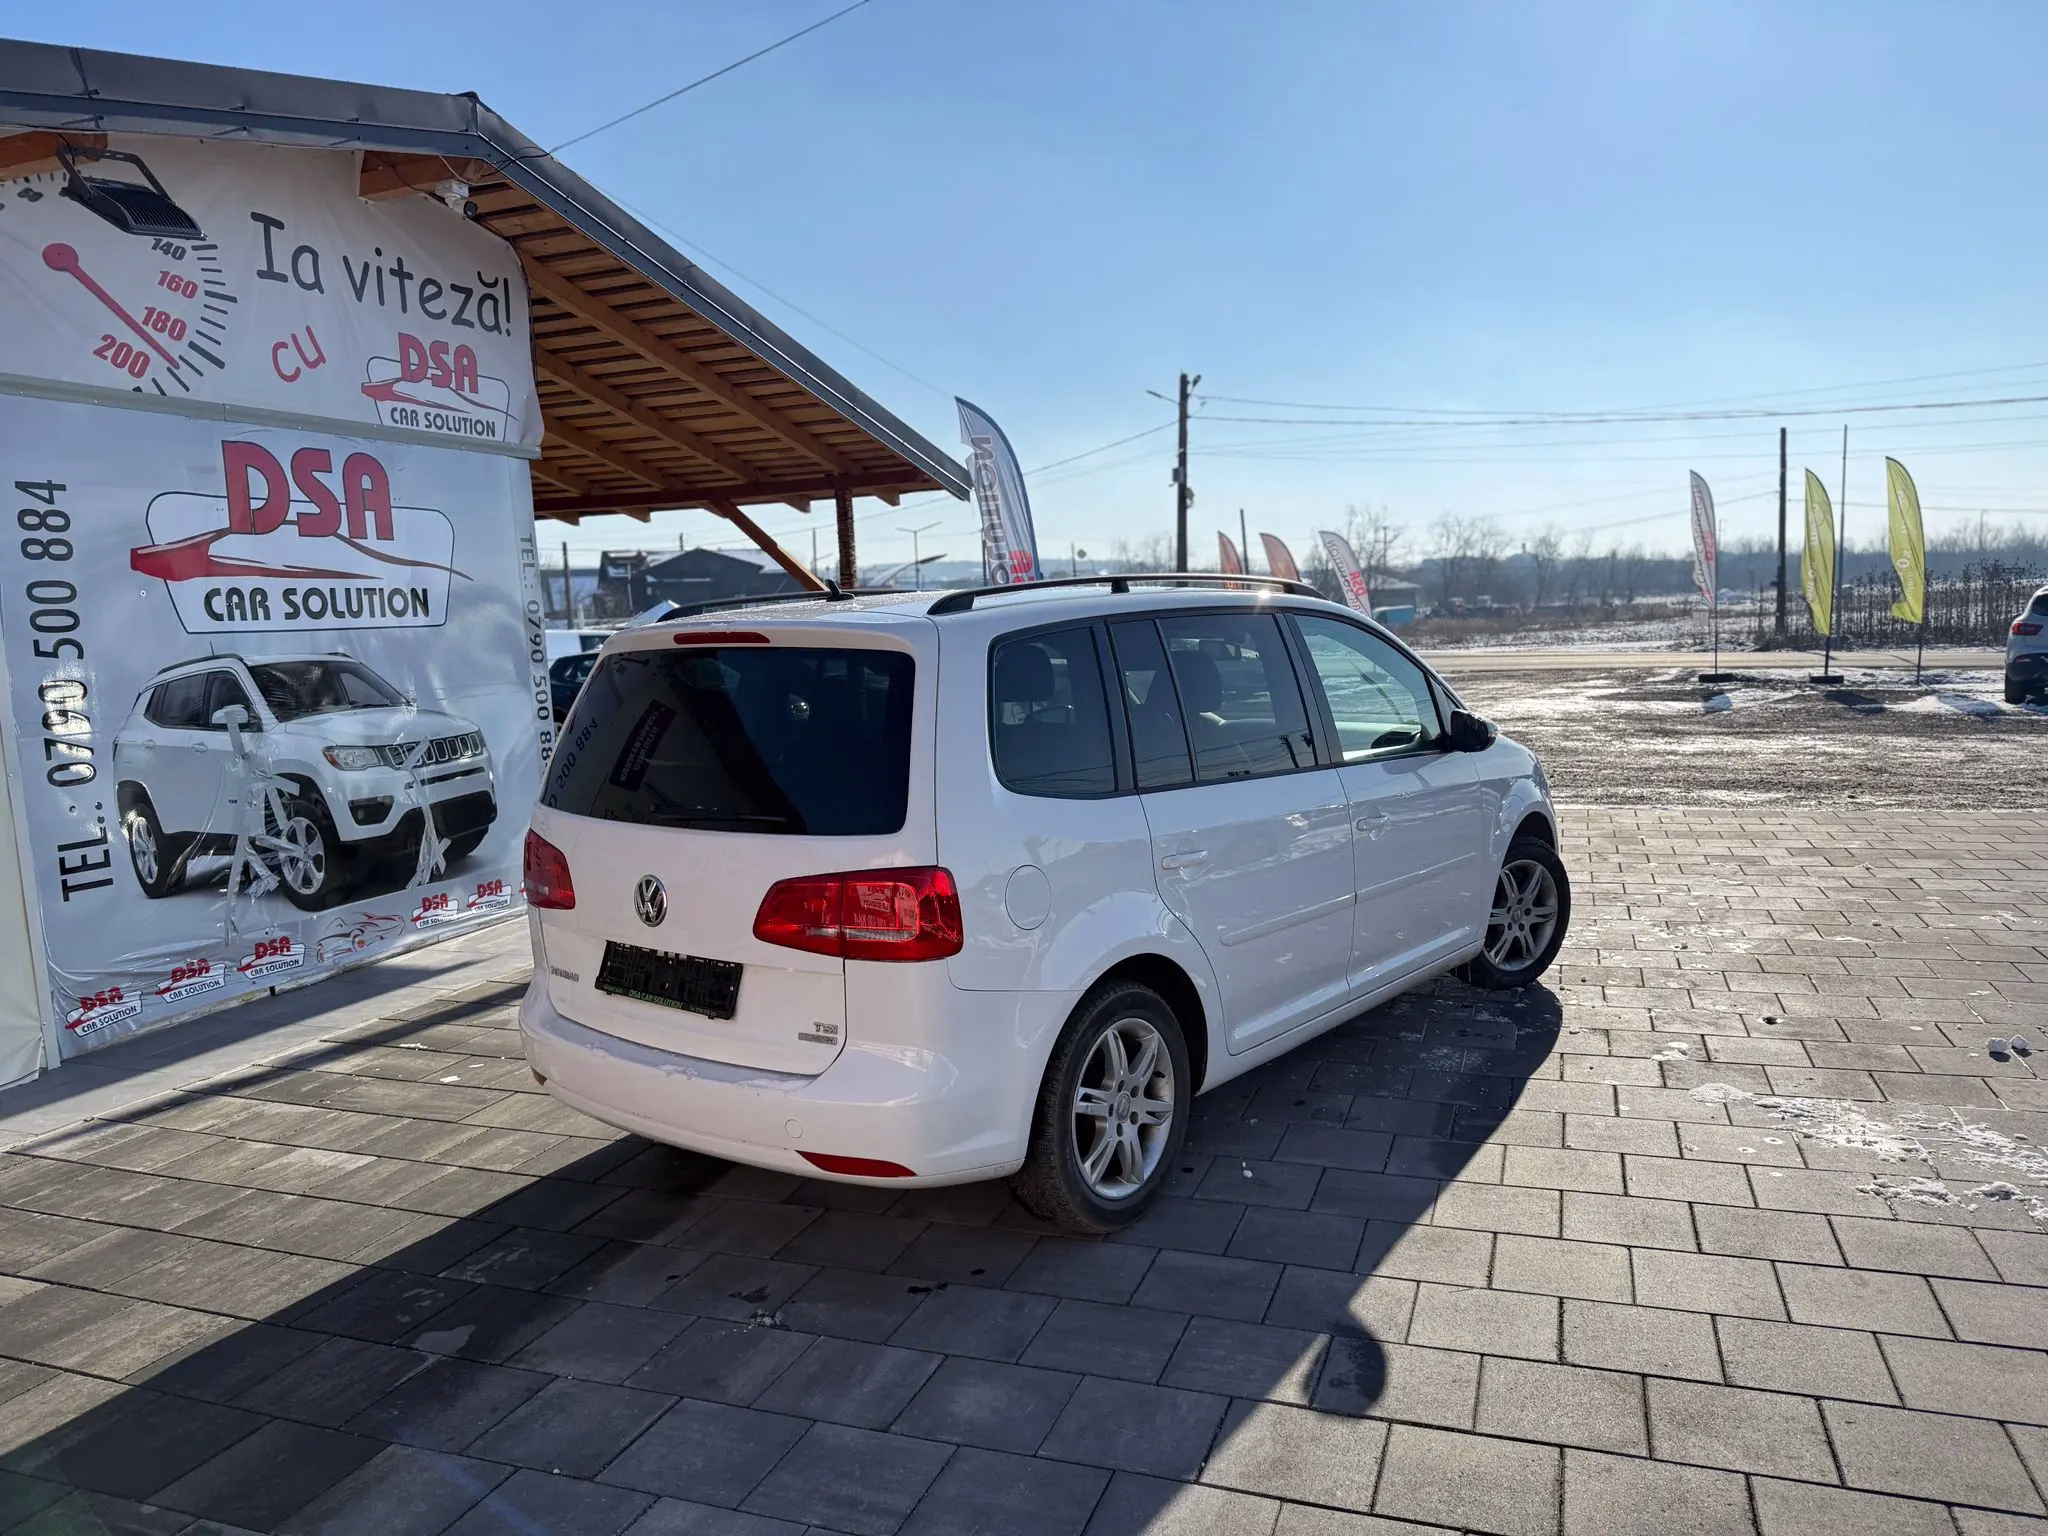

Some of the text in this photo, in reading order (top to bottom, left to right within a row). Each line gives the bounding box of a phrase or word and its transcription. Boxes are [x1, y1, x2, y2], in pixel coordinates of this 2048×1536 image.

[151, 237, 187, 261] 140
[157, 270, 199, 299] 160
[250, 211, 511, 337] Ia viteză!
[141, 306, 187, 342] 180
[92, 334, 151, 379] 200
[271, 325, 327, 382] cu
[398, 332, 479, 394] DSA
[390, 406, 496, 438] CAR SOLUTION
[221, 440, 394, 541] DSA
[14, 479, 74, 562] 884
[26, 580, 84, 660] 500
[203, 587, 430, 622] CAR SOLUTION
[526, 600, 544, 664] 0790
[532, 675, 550, 721] 500
[540, 731, 552, 775] 88
[57, 801, 114, 902] TEL.:
[422, 893, 449, 912] DSA
[477, 879, 503, 898] DSA
[419, 919, 430, 928] CAR
[254, 936, 291, 960] DSA
[171, 958, 211, 984] DSA
[250, 958, 300, 977] CAR SOLUTION
[79, 986, 124, 1013] DSA
[169, 979, 221, 1001] CAR SOLUTION
[81, 1007, 137, 1034] CAR SOLUTION
